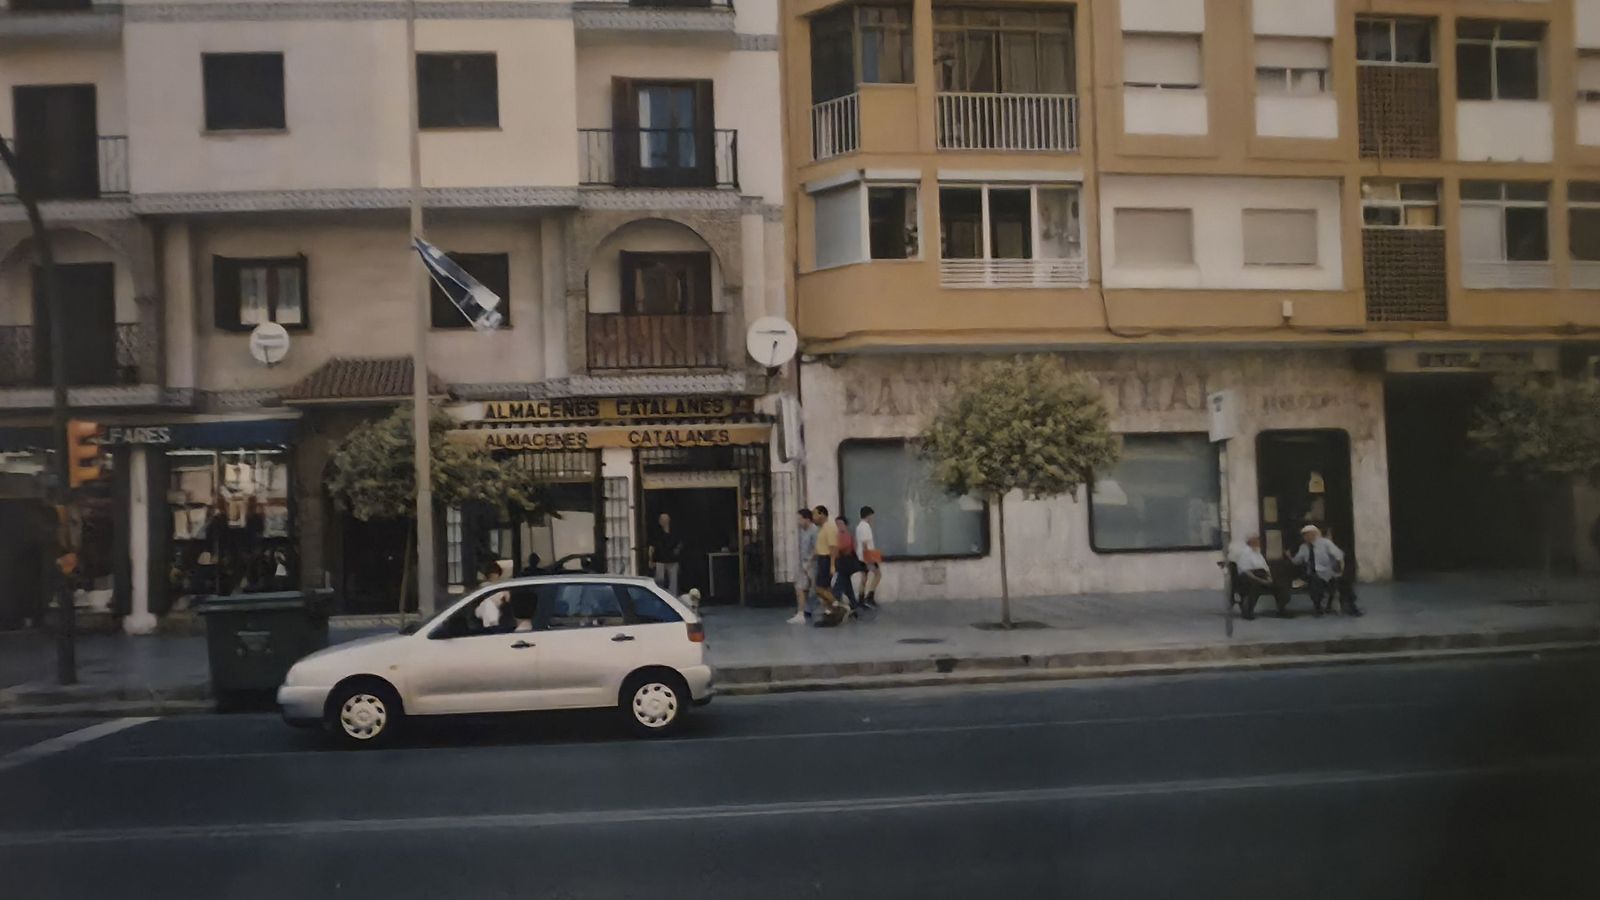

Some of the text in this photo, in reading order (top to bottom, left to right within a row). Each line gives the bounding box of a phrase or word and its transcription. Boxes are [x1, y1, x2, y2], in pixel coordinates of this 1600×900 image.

[486, 398, 724, 420] ALMACENES CATALANES
[485, 429, 730, 448] ALMACENES CATALANES
